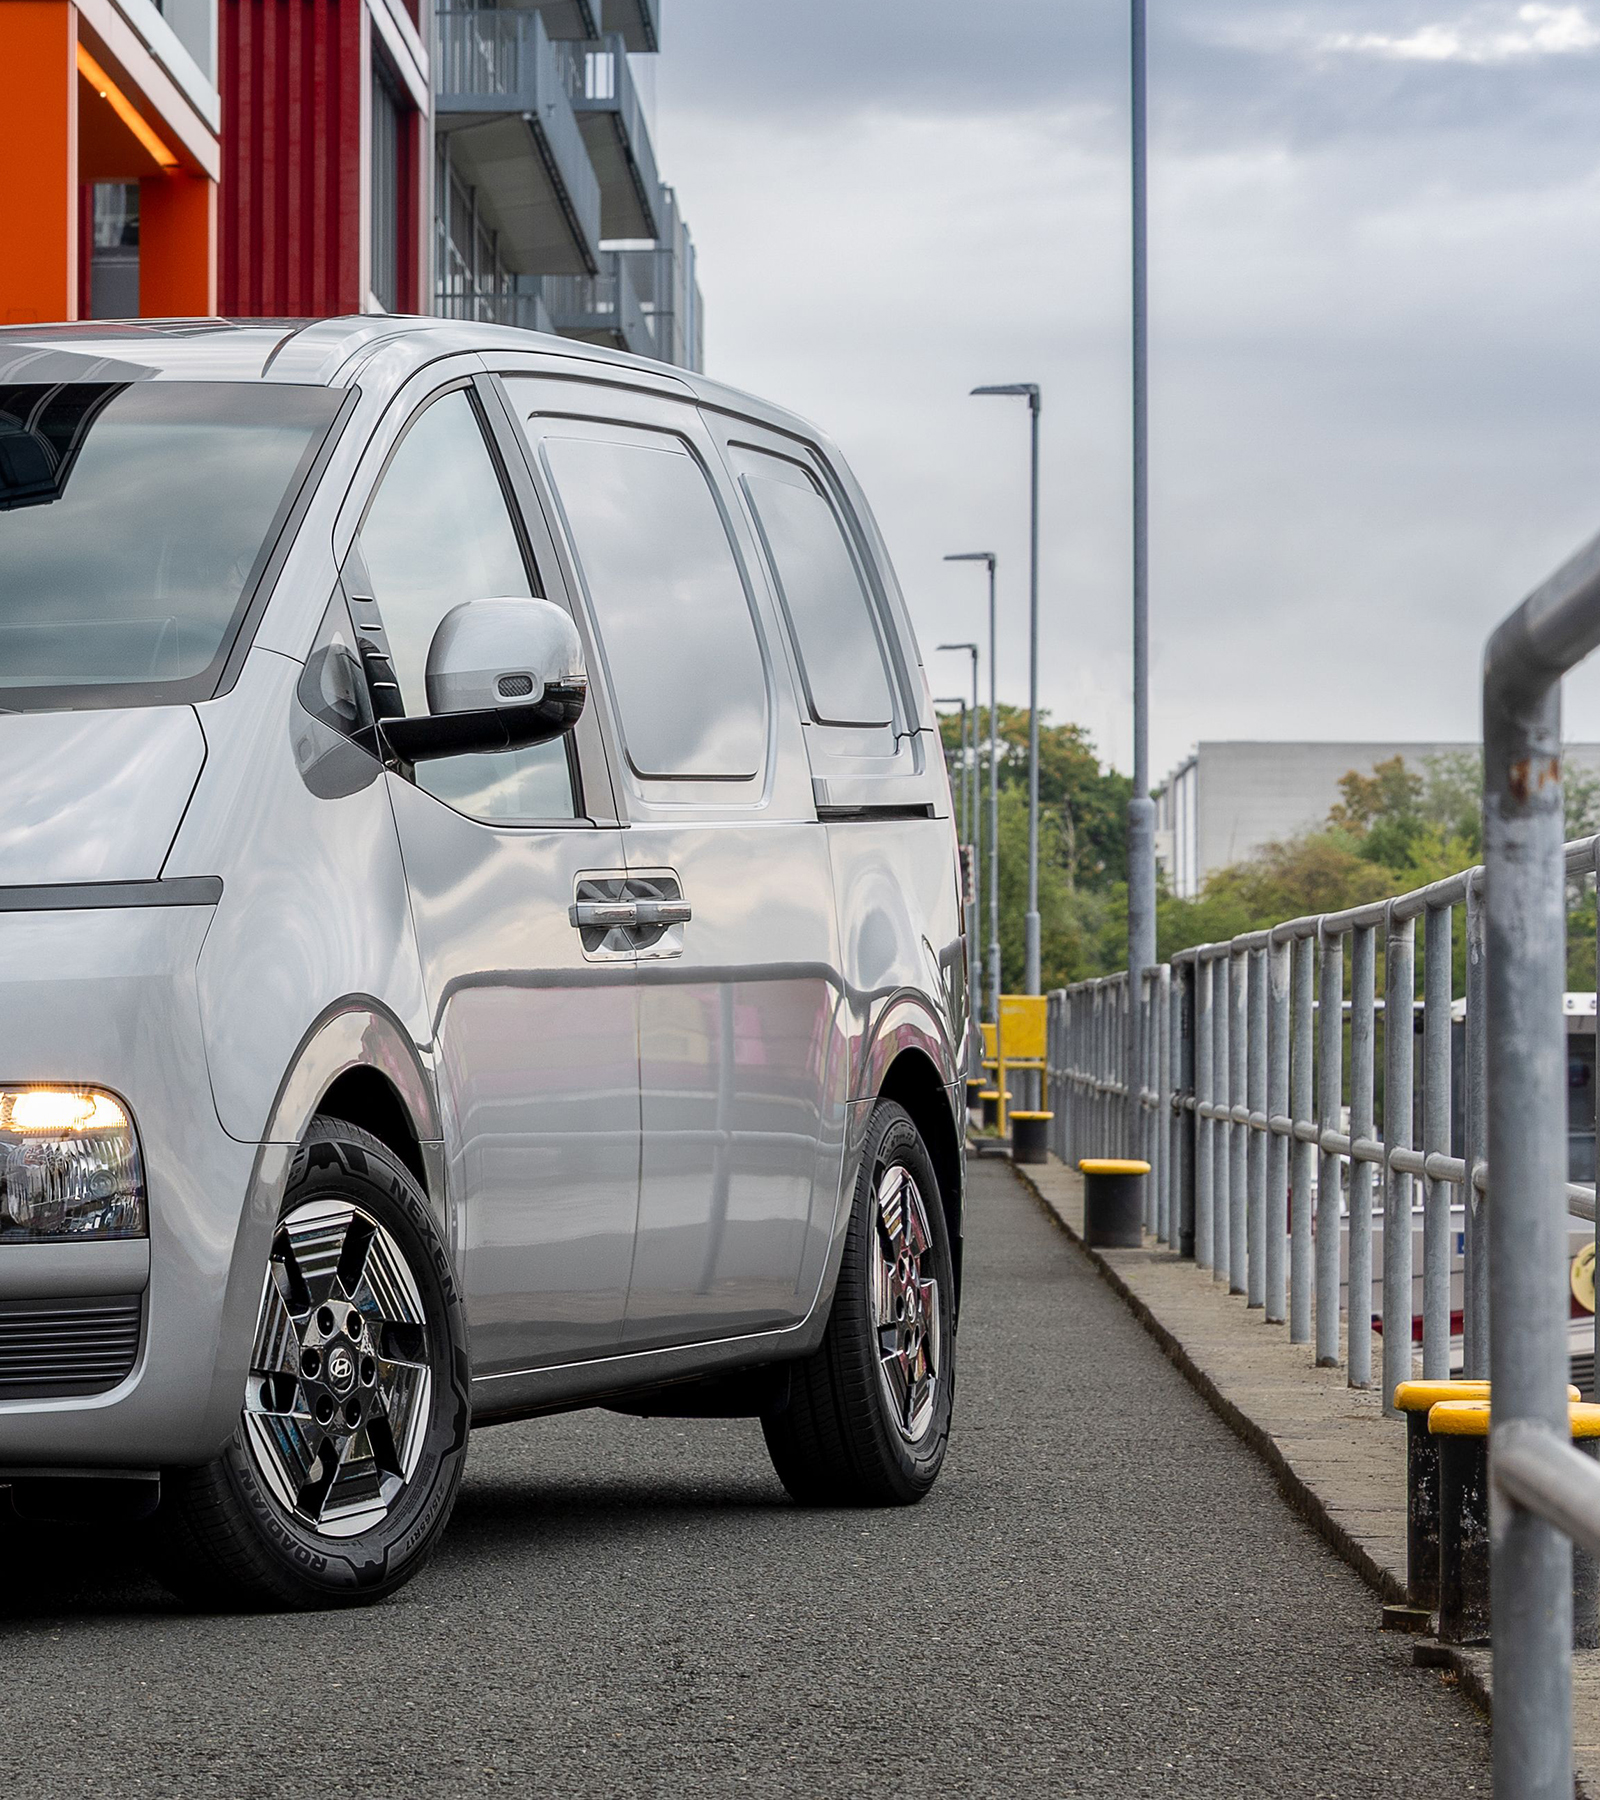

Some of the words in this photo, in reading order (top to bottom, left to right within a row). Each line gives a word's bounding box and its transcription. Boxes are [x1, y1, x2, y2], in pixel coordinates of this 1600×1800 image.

[389, 1176, 458, 1308] NEXEN
[239, 1468, 328, 1573] ROADIAN
[405, 1481, 445, 1552] 215/65R17
